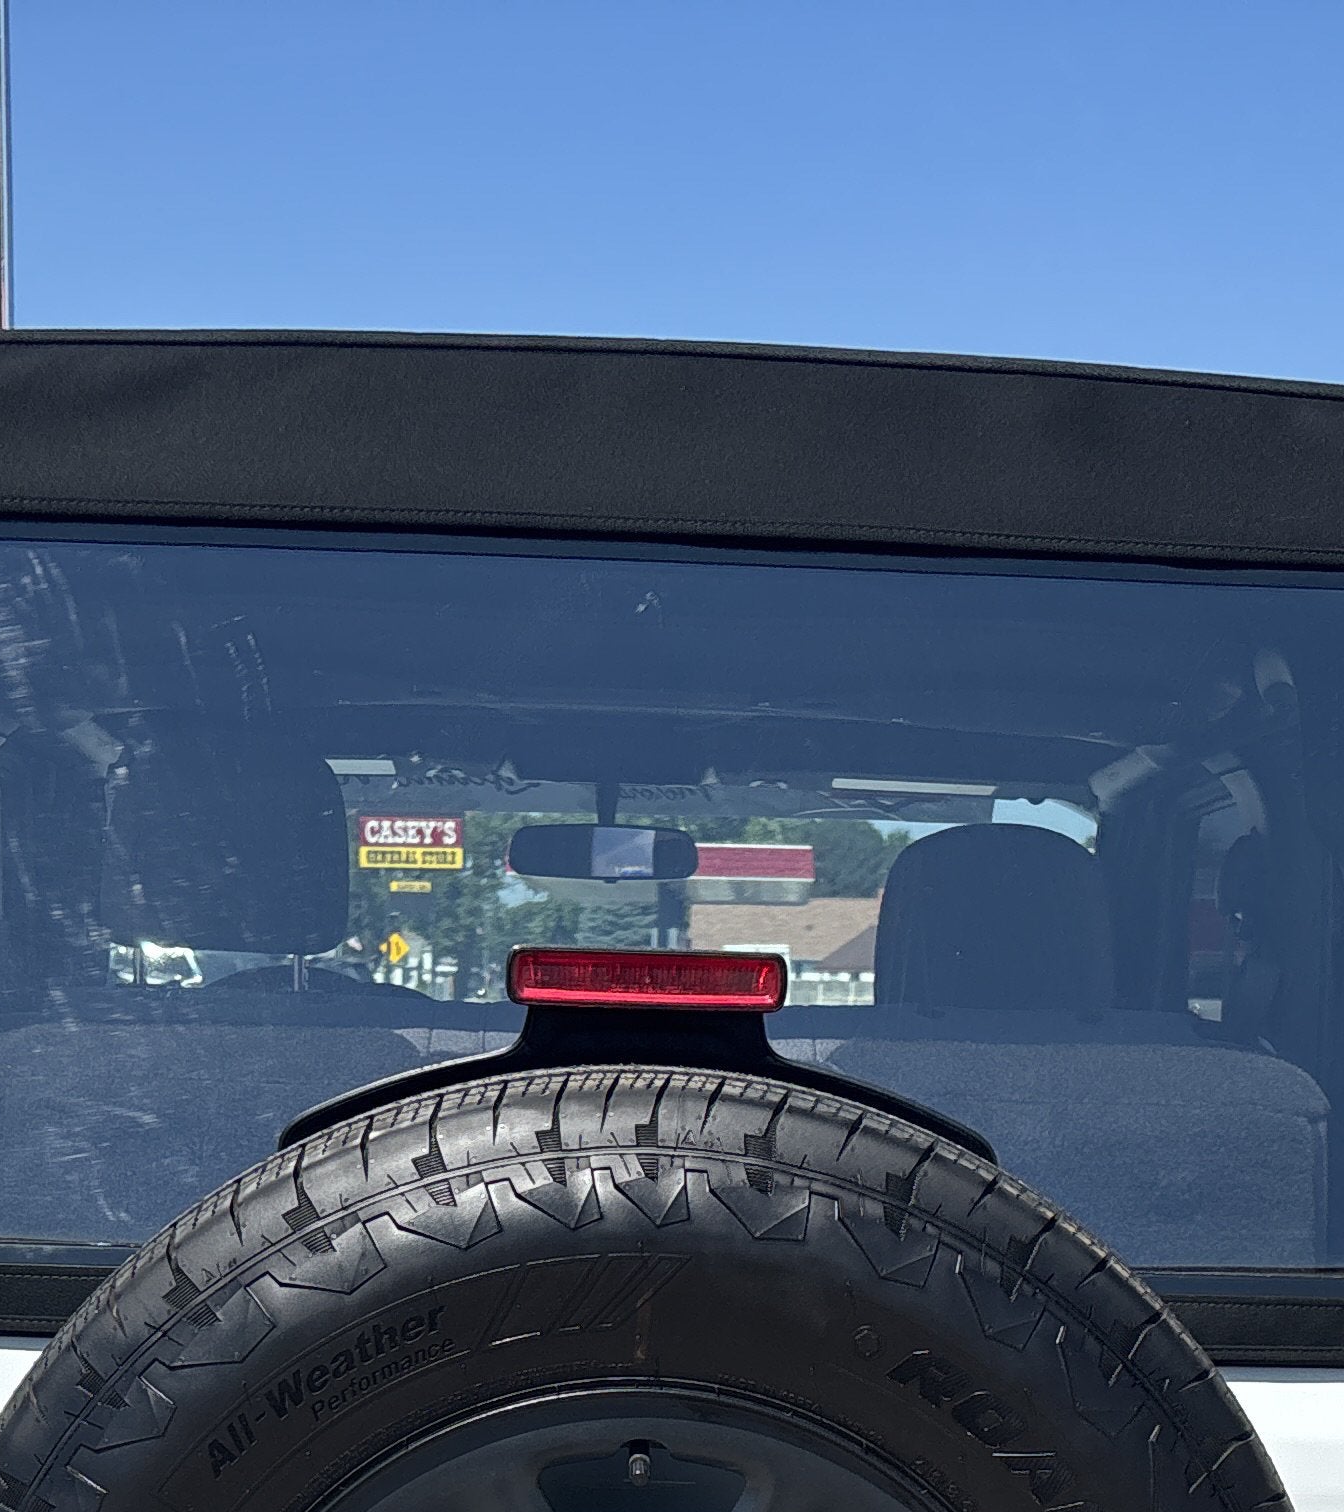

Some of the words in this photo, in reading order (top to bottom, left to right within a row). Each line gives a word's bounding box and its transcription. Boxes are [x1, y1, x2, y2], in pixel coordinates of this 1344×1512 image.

[364, 819, 457, 845] CASEY'S
[206, 1304, 447, 1480] All-Weather
[309, 1336, 456, 1423] Performance
